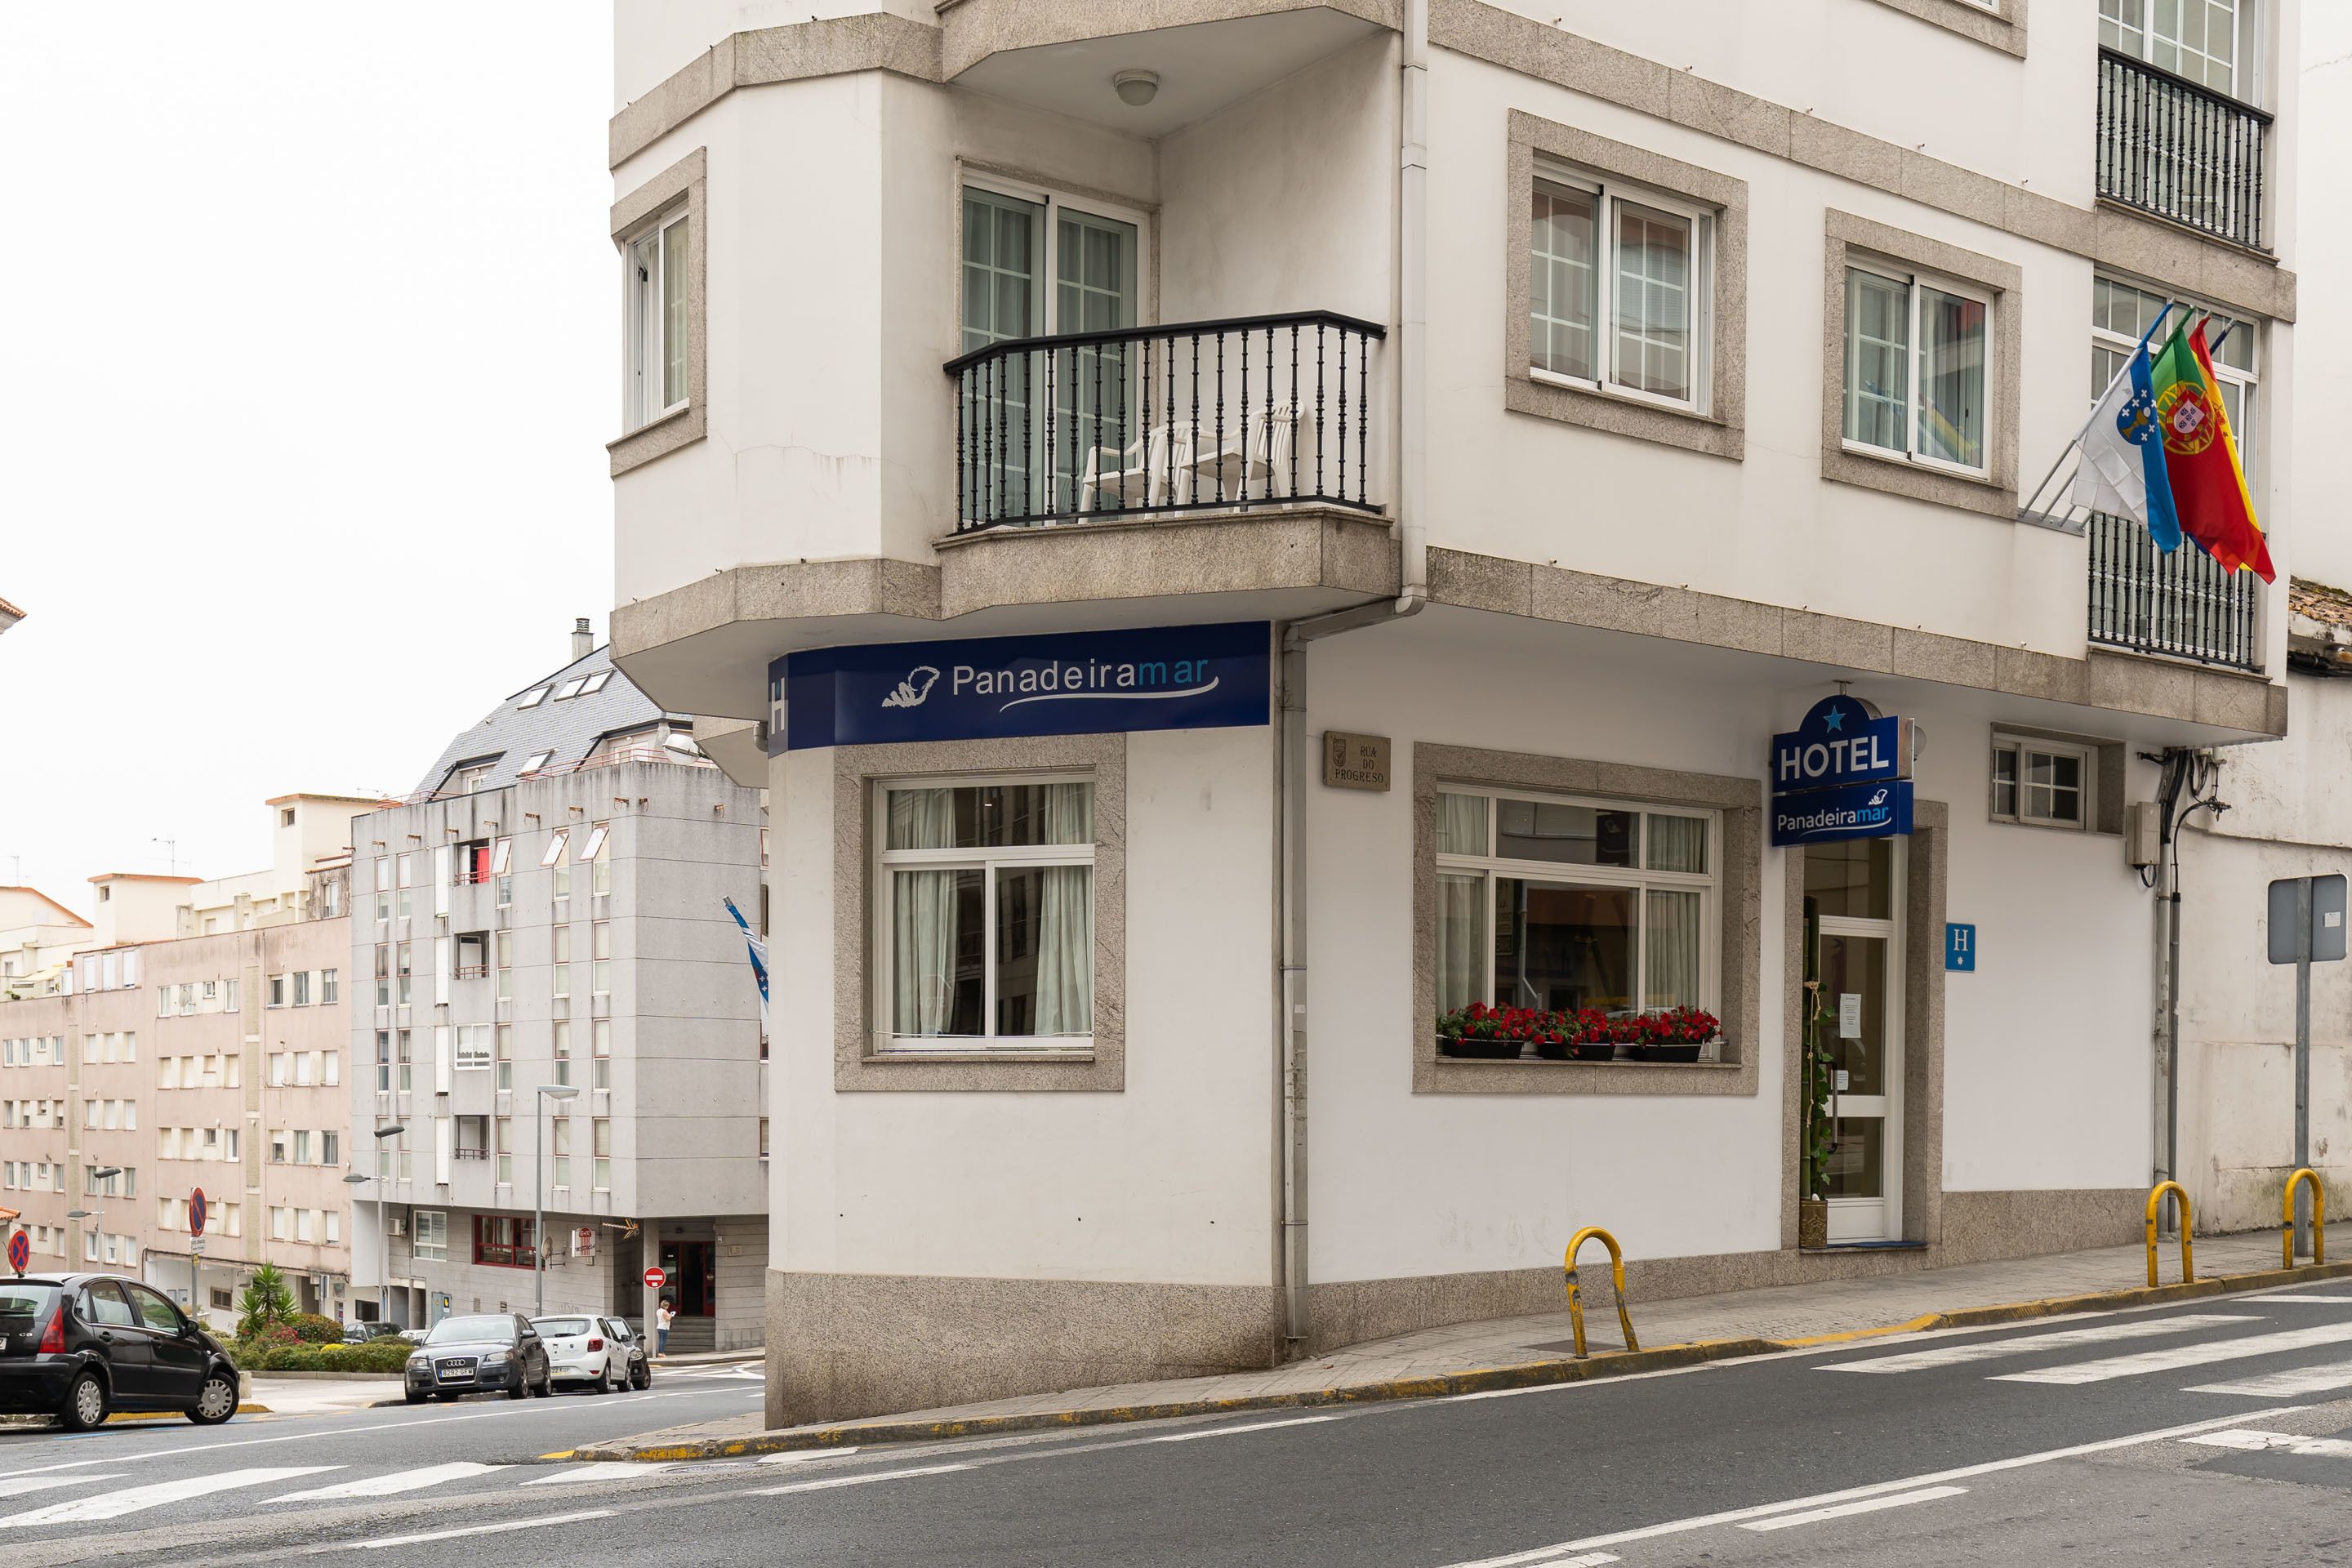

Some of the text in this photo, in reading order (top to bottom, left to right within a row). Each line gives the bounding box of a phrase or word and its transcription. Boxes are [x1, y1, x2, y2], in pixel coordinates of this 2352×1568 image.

[953, 658, 1209, 696] Panadeiramar
[771, 677, 785, 735] H
[1362, 759, 1374, 770] DO
[1780, 735, 1889, 781] HOTEL
[1335, 768, 1384, 784] PROGRESO
[1777, 806, 1889, 832] Panadeiramar
[1953, 929, 1969, 951] H
